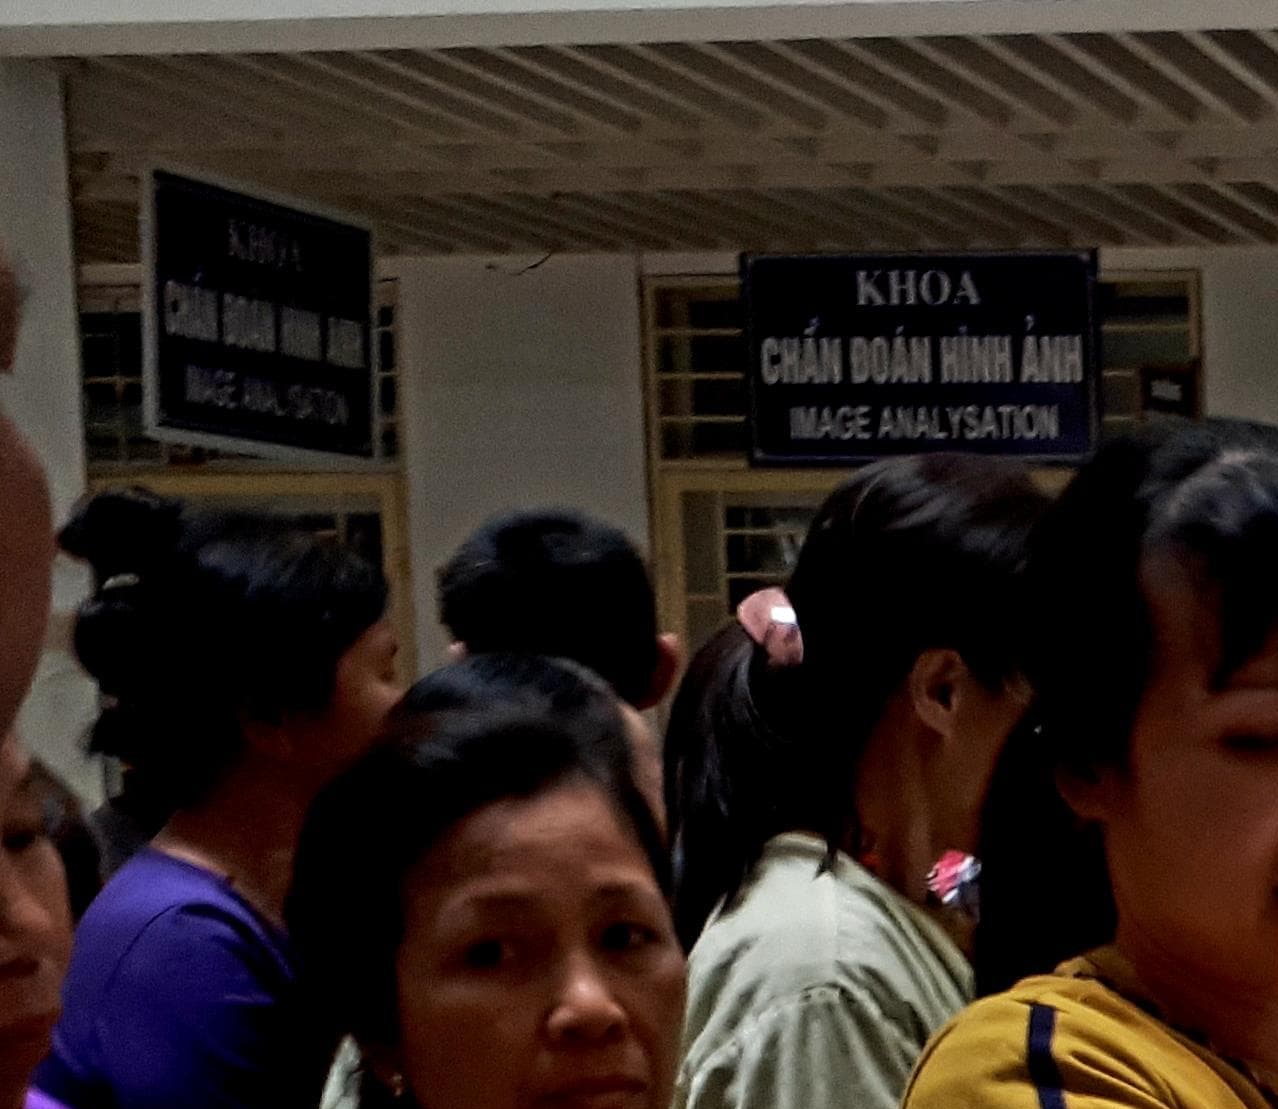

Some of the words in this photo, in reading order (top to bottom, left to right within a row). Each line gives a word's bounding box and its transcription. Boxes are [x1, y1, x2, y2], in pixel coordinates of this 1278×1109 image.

[856, 269, 981, 306] KHOA
[789, 404, 871, 440] IMAGE
[876, 404, 1060, 440] ANALYSATION
